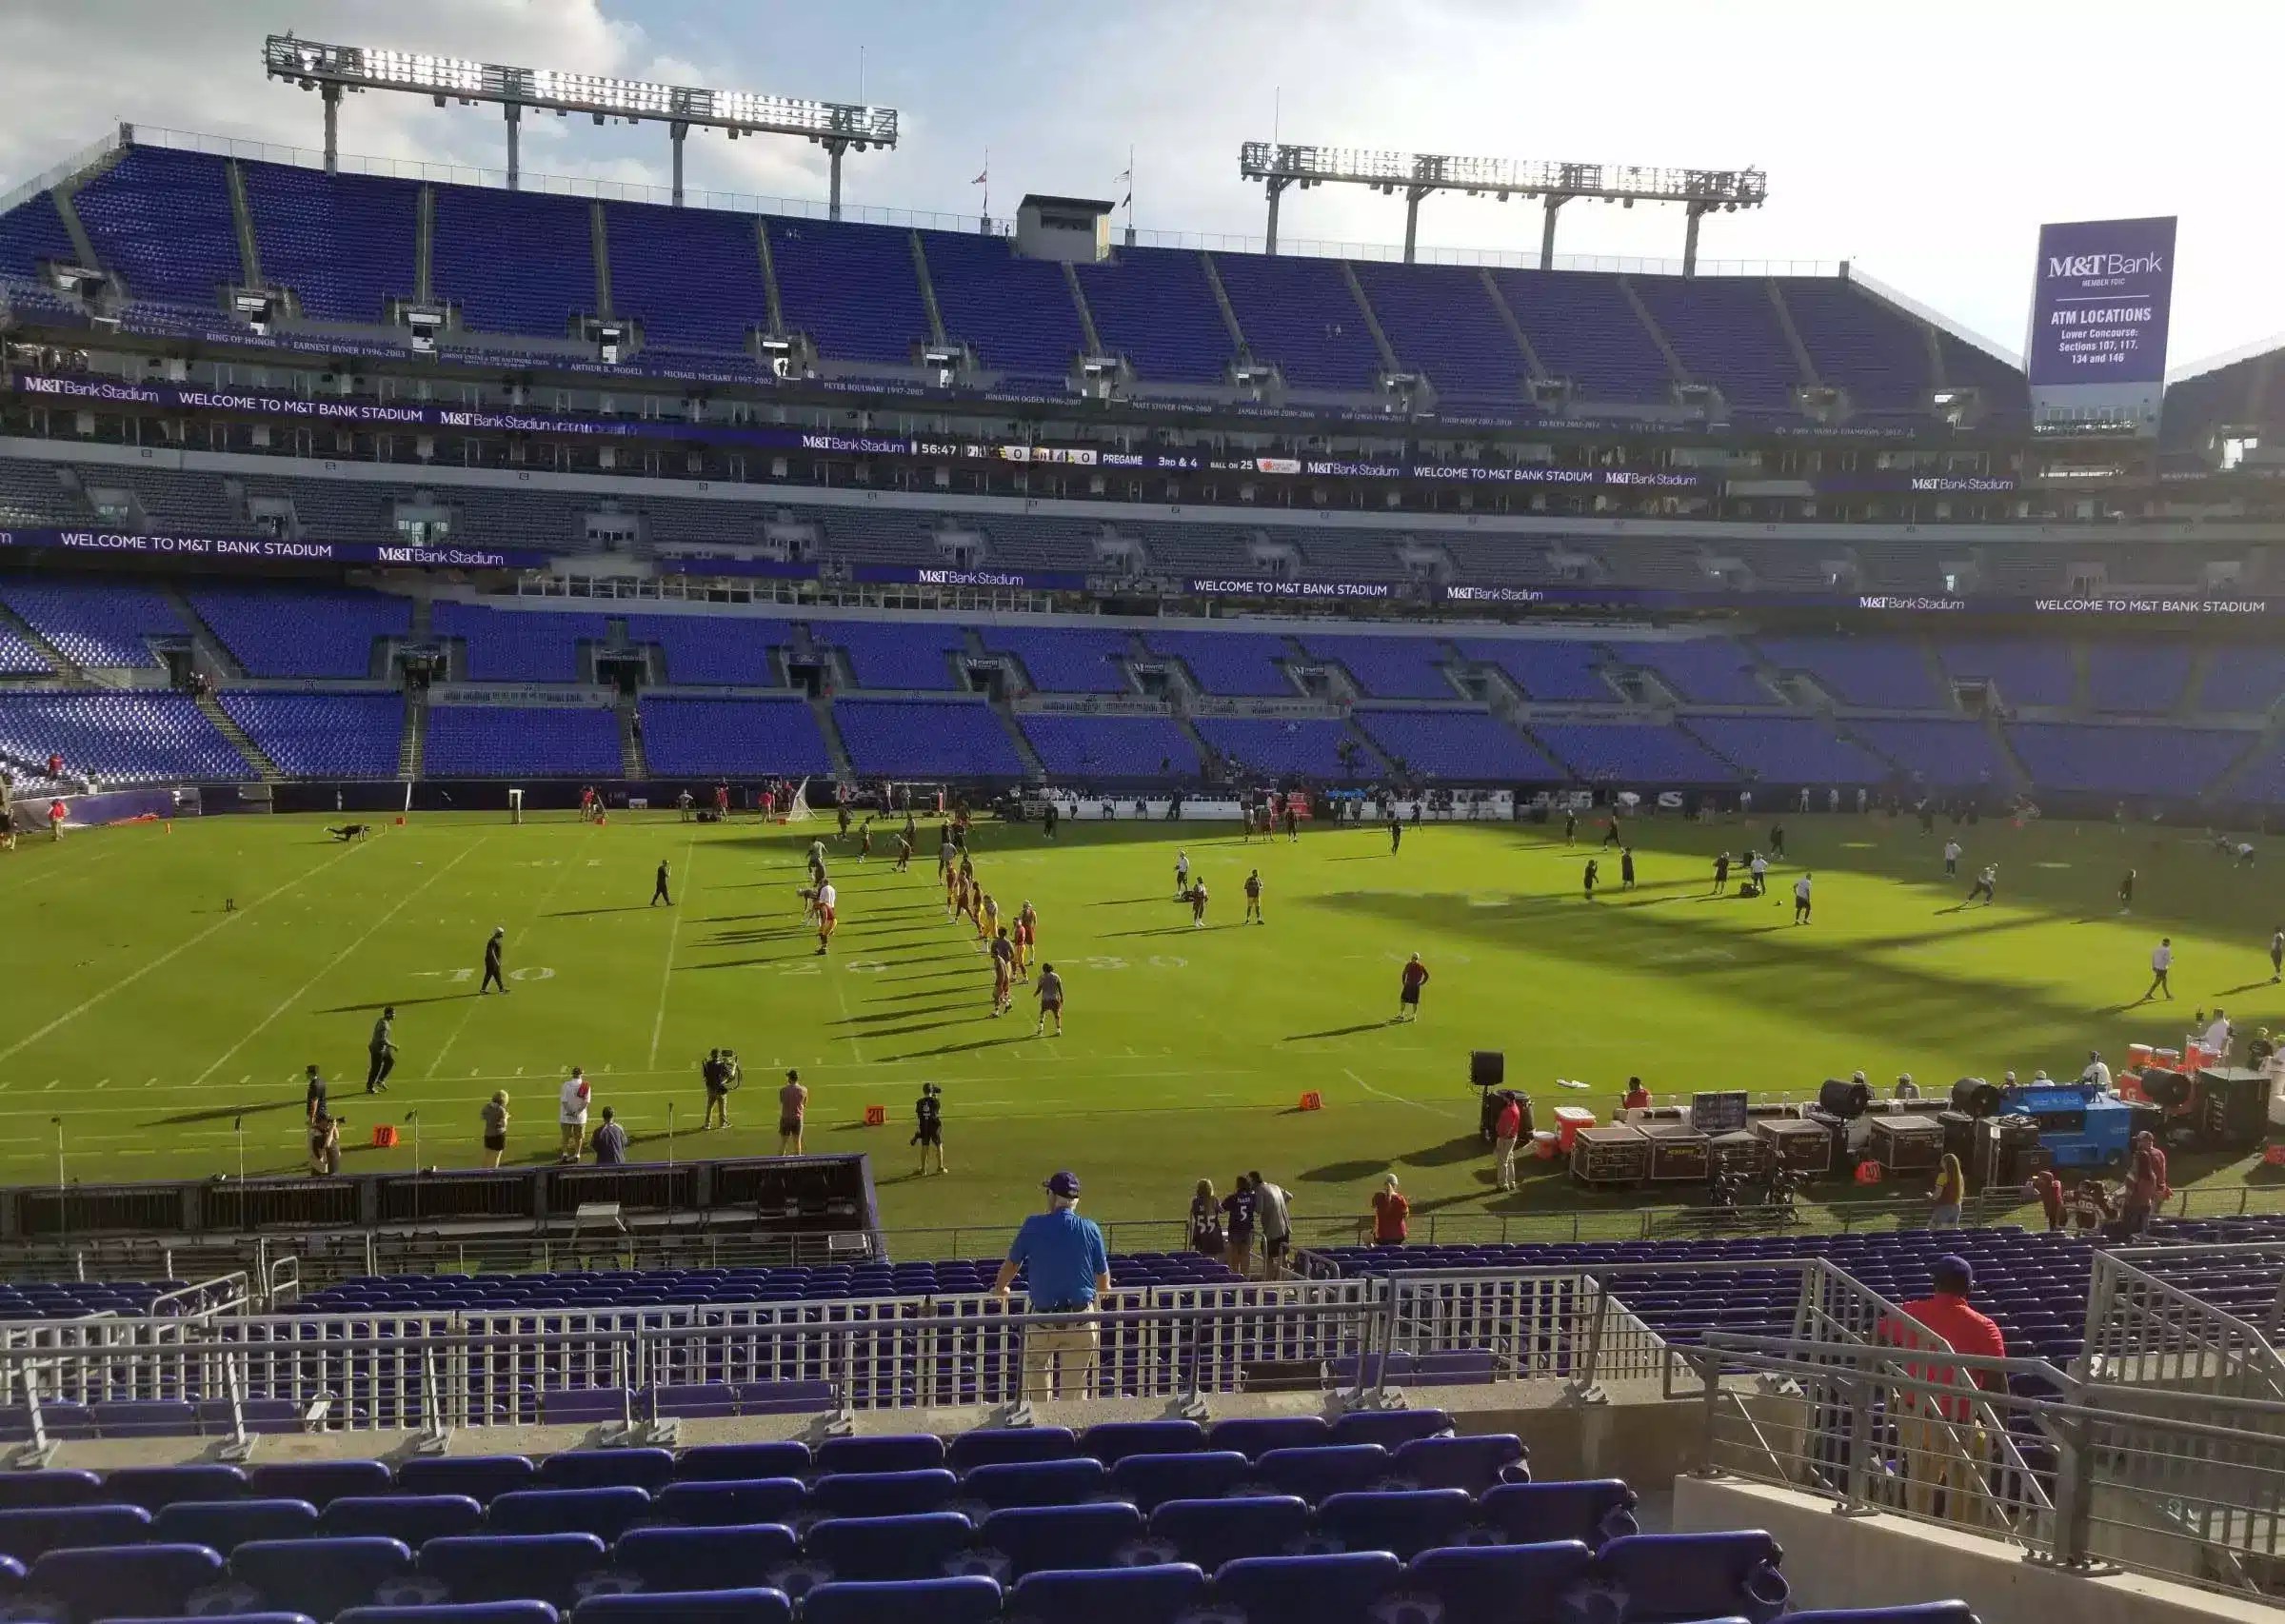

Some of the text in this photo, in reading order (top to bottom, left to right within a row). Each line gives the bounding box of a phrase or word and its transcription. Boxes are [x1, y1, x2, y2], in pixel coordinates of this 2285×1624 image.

[2048, 250, 2163, 278] M&T Bank
[2081, 279, 2109, 287] MEMBER
[2051, 307, 2152, 325] ATM LOCATIONS
[207, 333, 228, 343] RING
[244, 337, 276, 347] HONOR
[2061, 328, 2138, 339] Lower Concourse:
[293, 342, 330, 352] EARNEST
[332, 345, 359, 354] BYNER
[2058, 341, 2096, 352] Sections
[2098, 341, 2117, 351] 107,
[2072, 354, 2087, 364] 134
[2090, 354, 2106, 364] and
[571, 364, 602, 373] ARTHUR
[663, 369, 697, 380] MICHAEL
[24, 376, 159, 403] M&T Bank Stadium
[825, 382, 846, 390] PETER
[847, 384, 884, 393] BOULWARE
[984, 392, 1021, 402] JONATHAN
[1021, 394, 1045, 404] OGDEN
[179, 392, 423, 422] WELCOME TO M&T BANK STADIUM
[440, 411, 474, 426] M&T
[474, 413, 504, 428] Bank
[802, 434, 904, 454] M&T Bank Stadium
[921, 444, 957, 455] 56:47
[1103, 453, 1142, 465] PREGAME
[1158, 457, 1198, 467] 3RD & 4
[1210, 461, 1226, 469] BALL
[1240, 460, 1253, 470] 25
[1307, 461, 1333, 474] M&T
[1333, 463, 1358, 476] Bank
[1358, 464, 1400, 476] Stadium
[1414, 466, 1592, 483] WELCOME TO M&T BANK STADIUM
[1605, 471, 1697, 485] M&T Bank Stadium
[1912, 478, 2014, 491] M&T Bank Stadium
[61, 532, 332, 557] WELCOME TO M&T BANK STADIUM
[378, 546, 504, 565] M&T Bank Stadium
[919, 569, 1023, 586] M&T Bank Stadium
[1194, 580, 1387, 596] WELCOME TO M&T BANK STADIUM
[1447, 586, 1543, 602] M&T Bank Stadium
[1858, 596, 1965, 610] M&T Bank Stadium
[2036, 599, 2265, 613] WELCOME TO M&T BANK STADIUM
[868, 1108, 884, 1123] 20
[377, 1127, 391, 1145] 10
[1240, 1205, 1247, 1221] 5
[1198, 1215, 1217, 1234] 55
